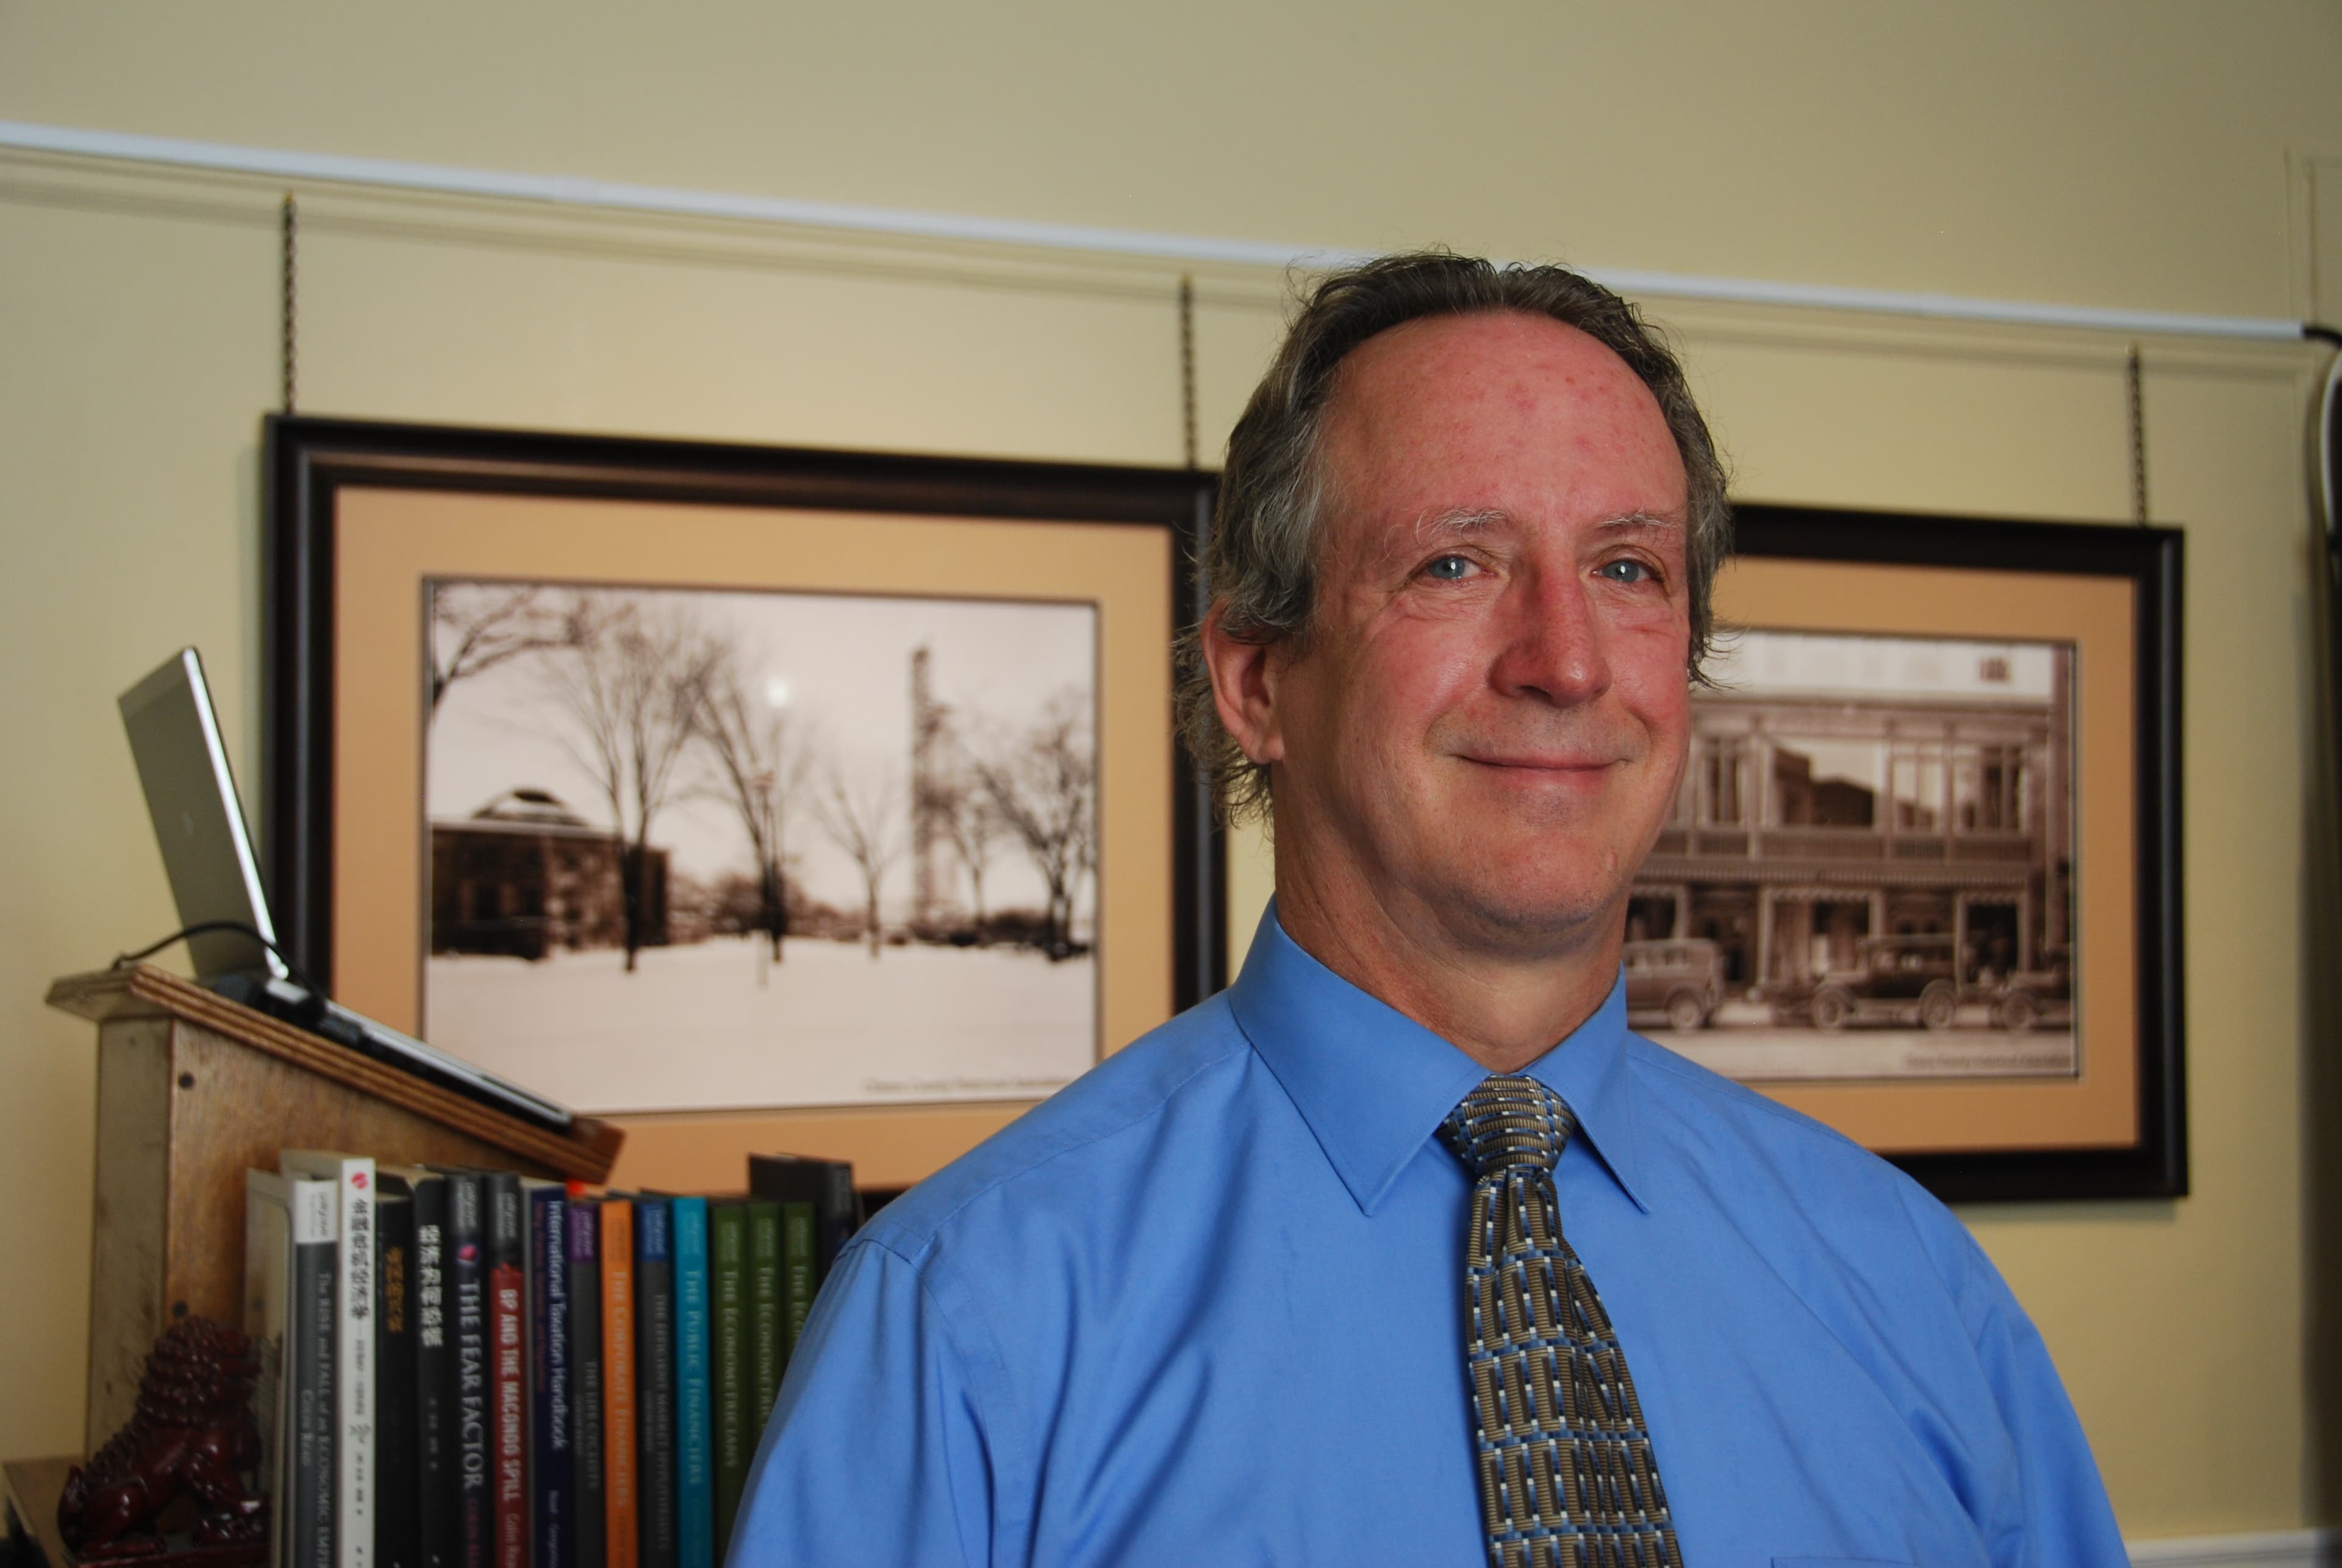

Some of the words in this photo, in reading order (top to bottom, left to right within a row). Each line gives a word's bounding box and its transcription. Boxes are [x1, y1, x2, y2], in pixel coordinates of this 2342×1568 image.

[548, 1201, 566, 1298] International
[459, 1280, 481, 1327] THE
[498, 1288, 518, 1311] BP
[500, 1313, 520, 1345] AND
[549, 1303, 567, 1366] Taxation
[460, 1334, 482, 1391] FEAR
[501, 1347, 520, 1376] THE
[501, 1380, 521, 1455] MACONDO
[551, 1367, 568, 1450] Handbook
[461, 1396, 484, 1490] FACTOR
[502, 1458, 522, 1502] SPILL
